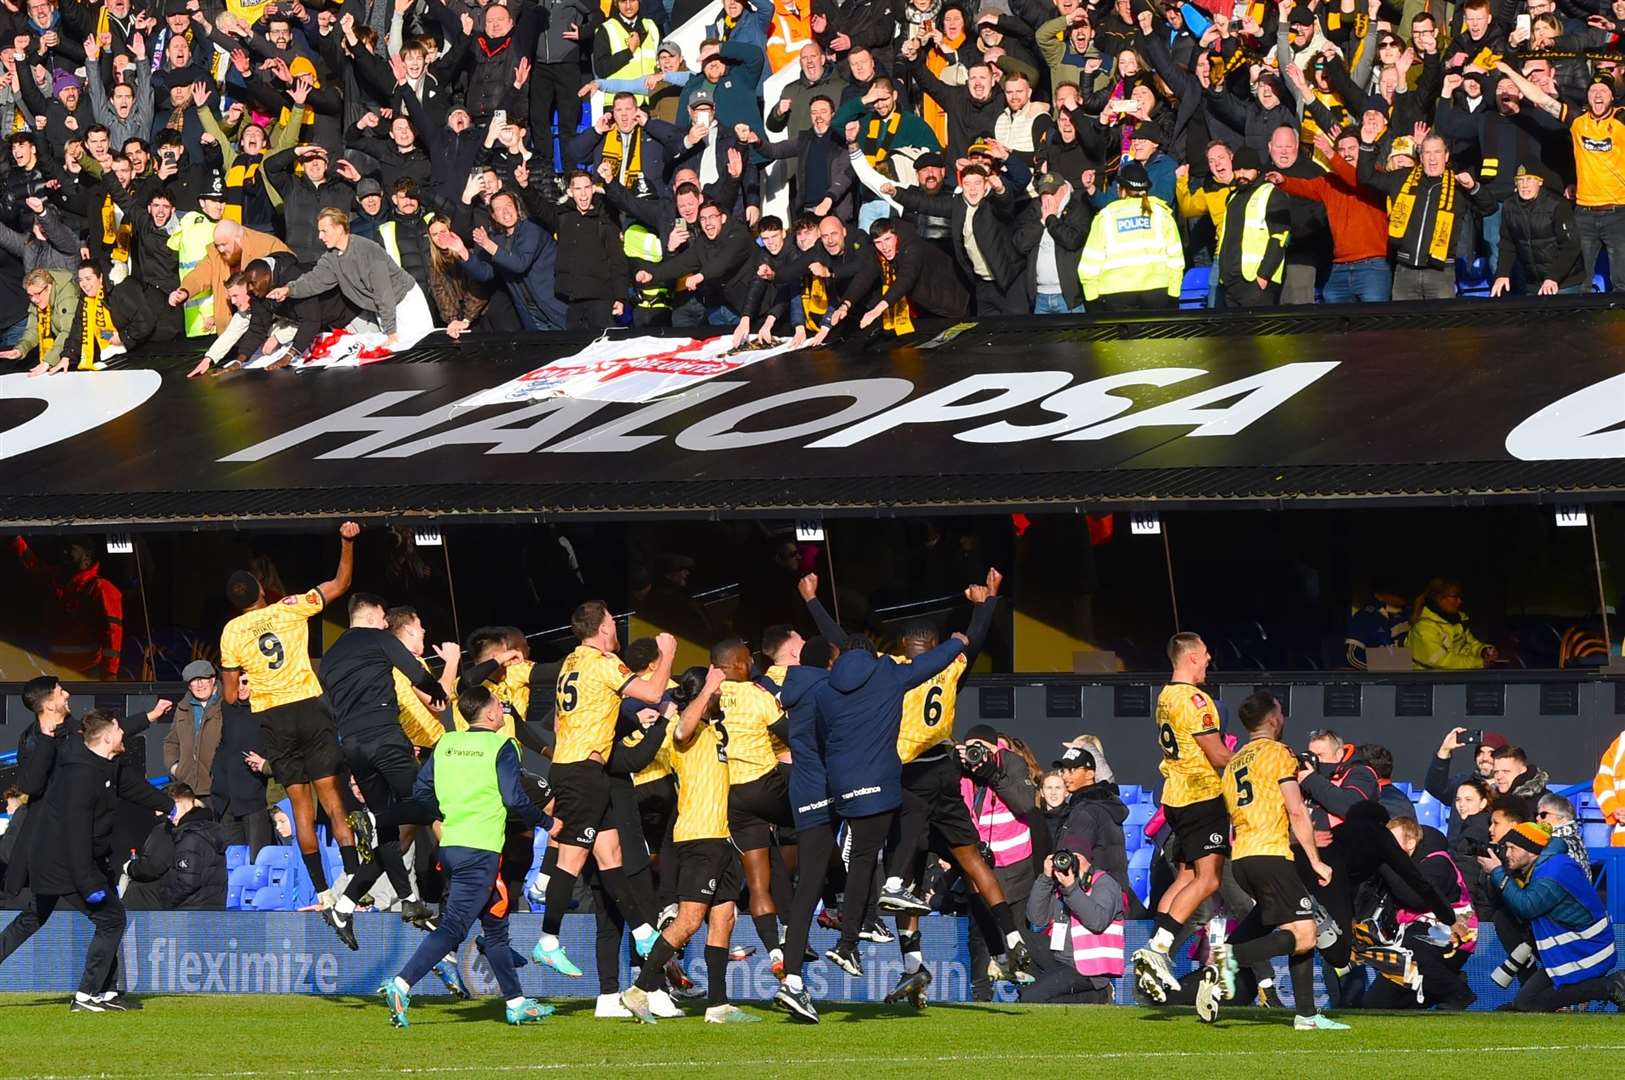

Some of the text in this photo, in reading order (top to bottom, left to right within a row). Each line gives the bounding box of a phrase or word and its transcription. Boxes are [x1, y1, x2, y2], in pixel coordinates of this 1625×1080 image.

[1118, 217, 1150, 231] POLICE
[1136, 512, 1154, 530] R8
[1561, 504, 1579, 521] R7
[417, 526, 438, 541] R10
[801, 520, 817, 536] R9
[258, 632, 284, 670] 9
[924, 686, 943, 727] 6
[1235, 766, 1254, 806] 5
[798, 804, 812, 814] new
[148, 937, 339, 993] fleximize
